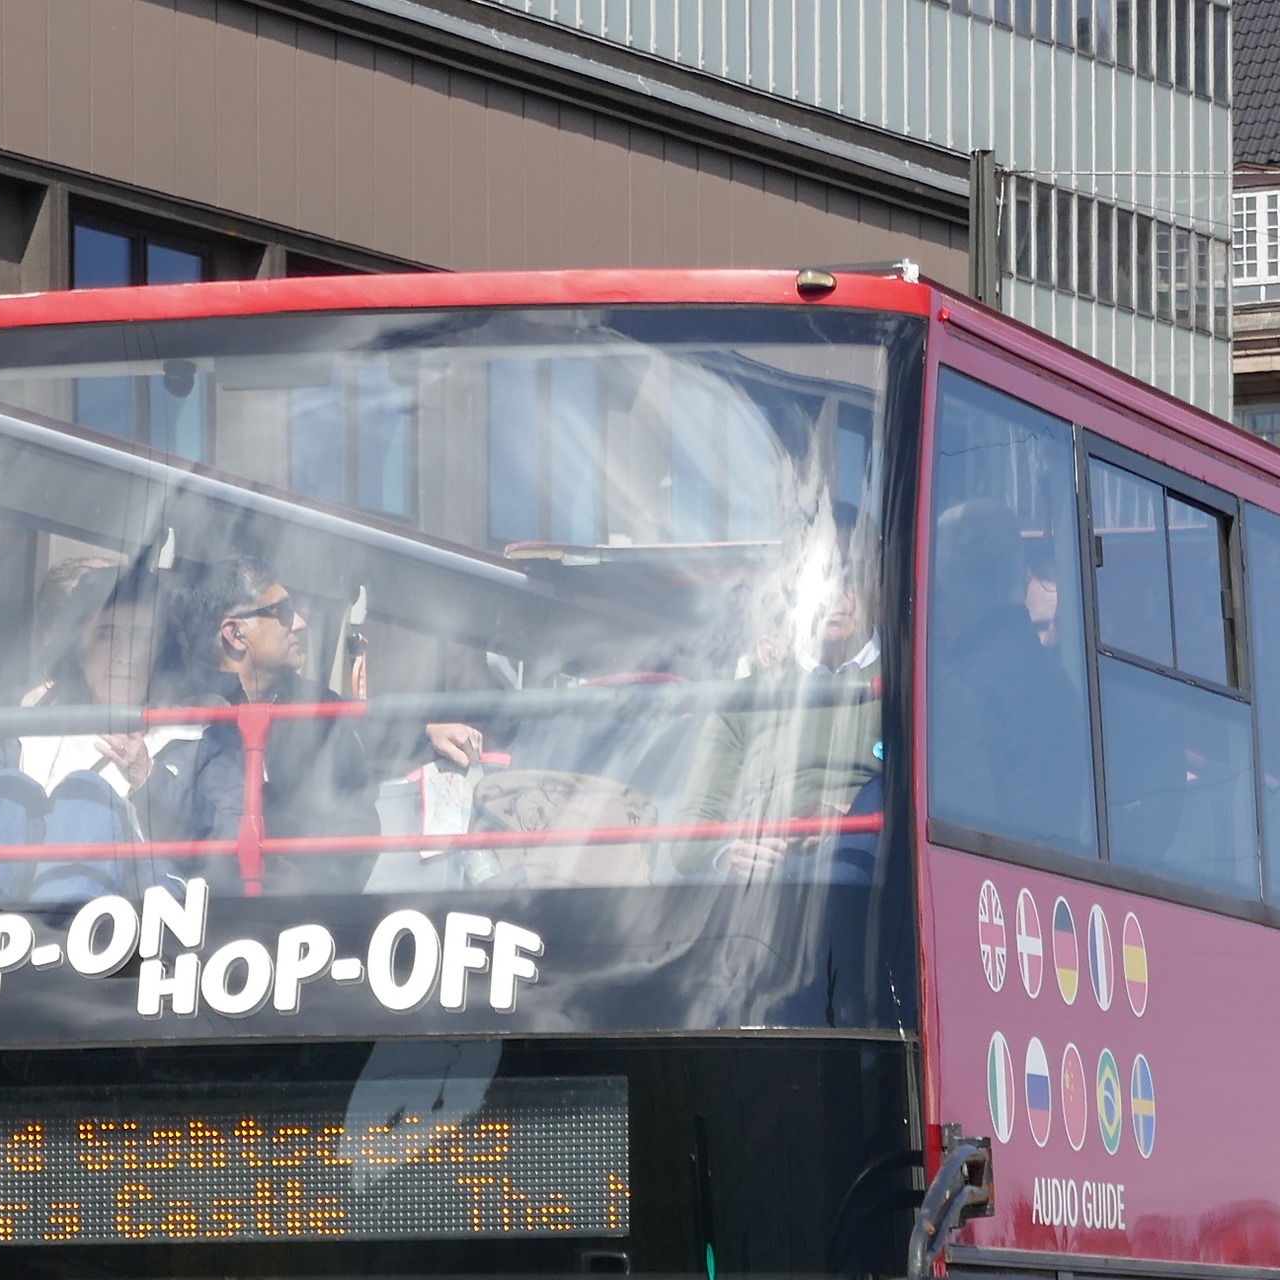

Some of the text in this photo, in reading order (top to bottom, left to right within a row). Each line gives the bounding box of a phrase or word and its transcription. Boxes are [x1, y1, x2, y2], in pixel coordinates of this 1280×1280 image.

[137, 909, 542, 1017] HOP-OFF
[116, 1180, 346, 1240] Castle
[457, 1176, 572, 1232] The
[1032, 1177, 1126, 1230] AUDIO GUIDE
